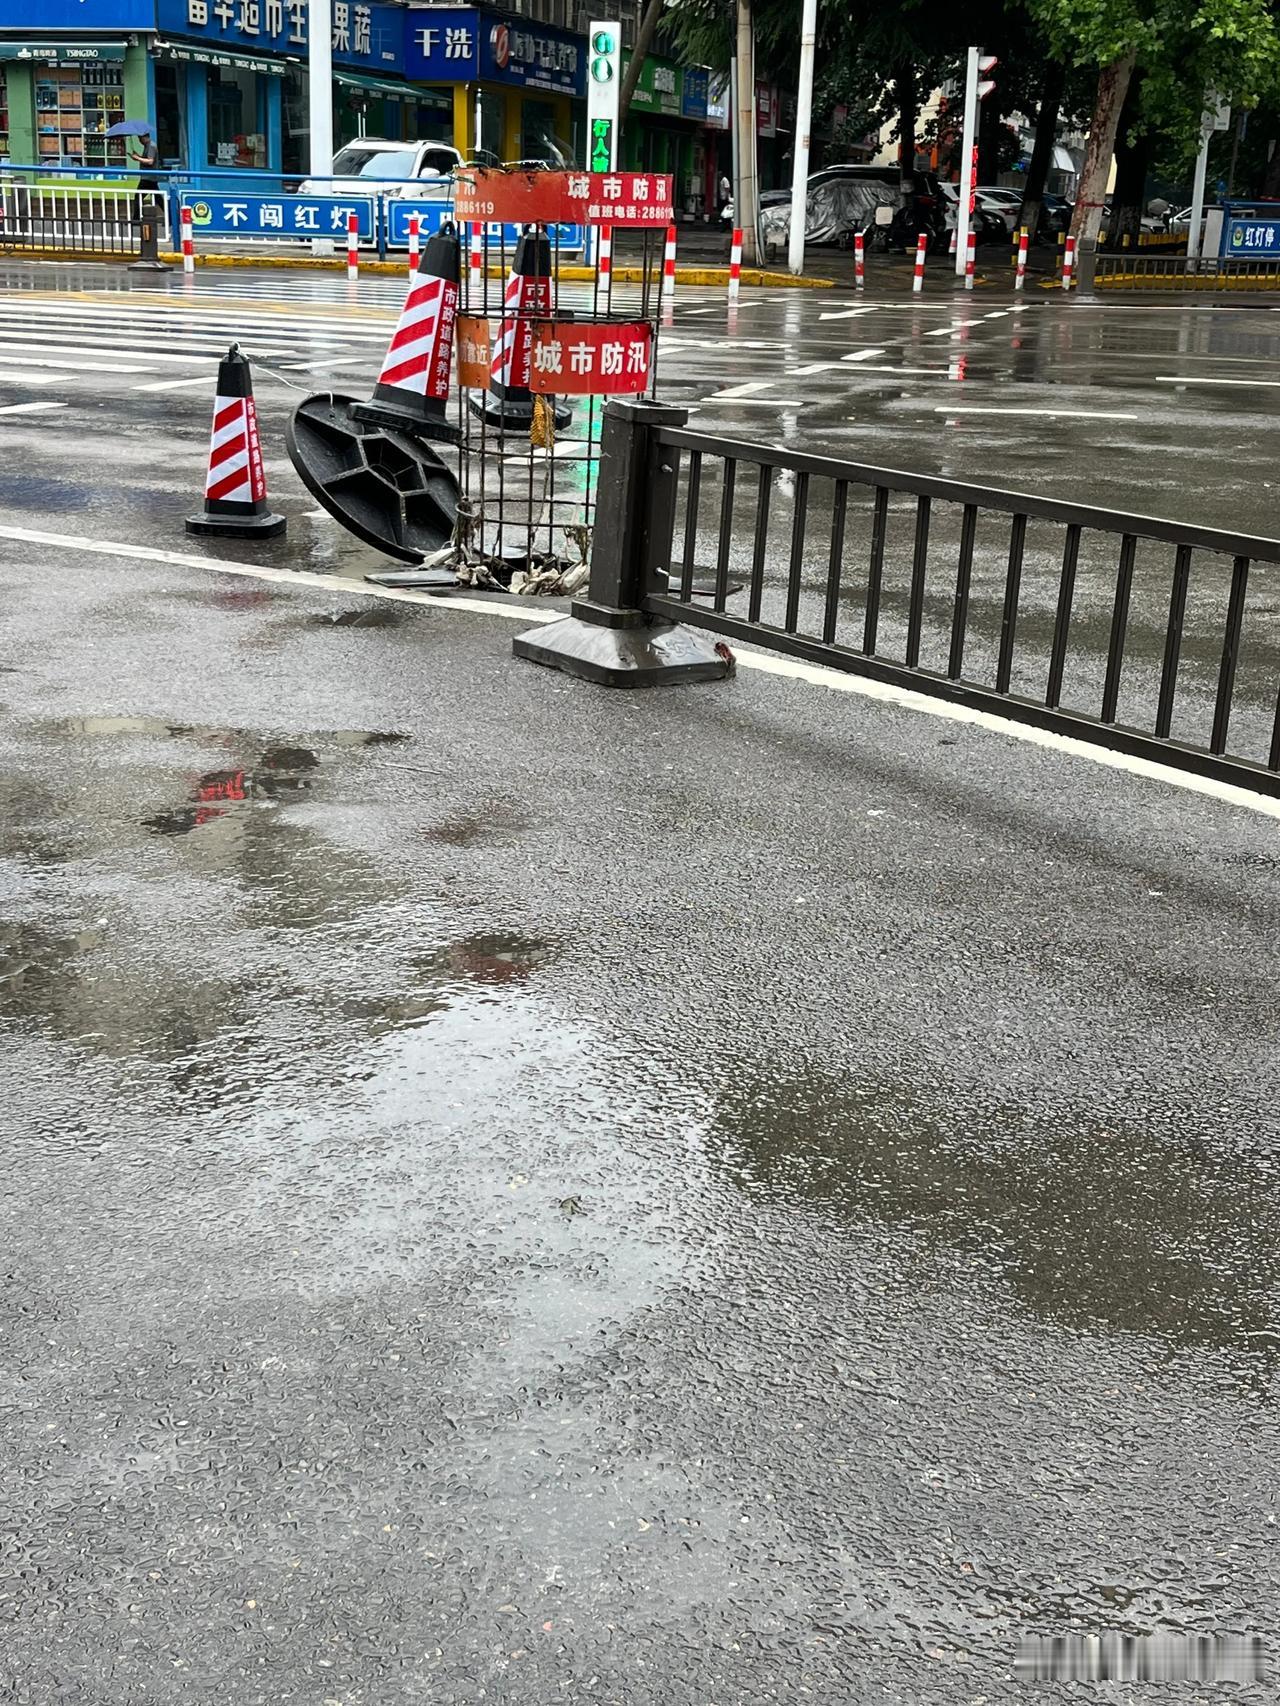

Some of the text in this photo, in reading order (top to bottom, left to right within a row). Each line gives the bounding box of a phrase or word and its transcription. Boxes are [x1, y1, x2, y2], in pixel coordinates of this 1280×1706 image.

[66, 49, 98, 57] TSINGTAO
[414, 27, 473, 58] 干洗
[567, 176, 668, 201] 城市防汛
[222, 202, 358, 230] 不闯红灯
[1245, 226, 1275, 248] 红灯停
[435, 288, 457, 396] 市政道路养护
[534, 340, 647, 376] 城市防汛
